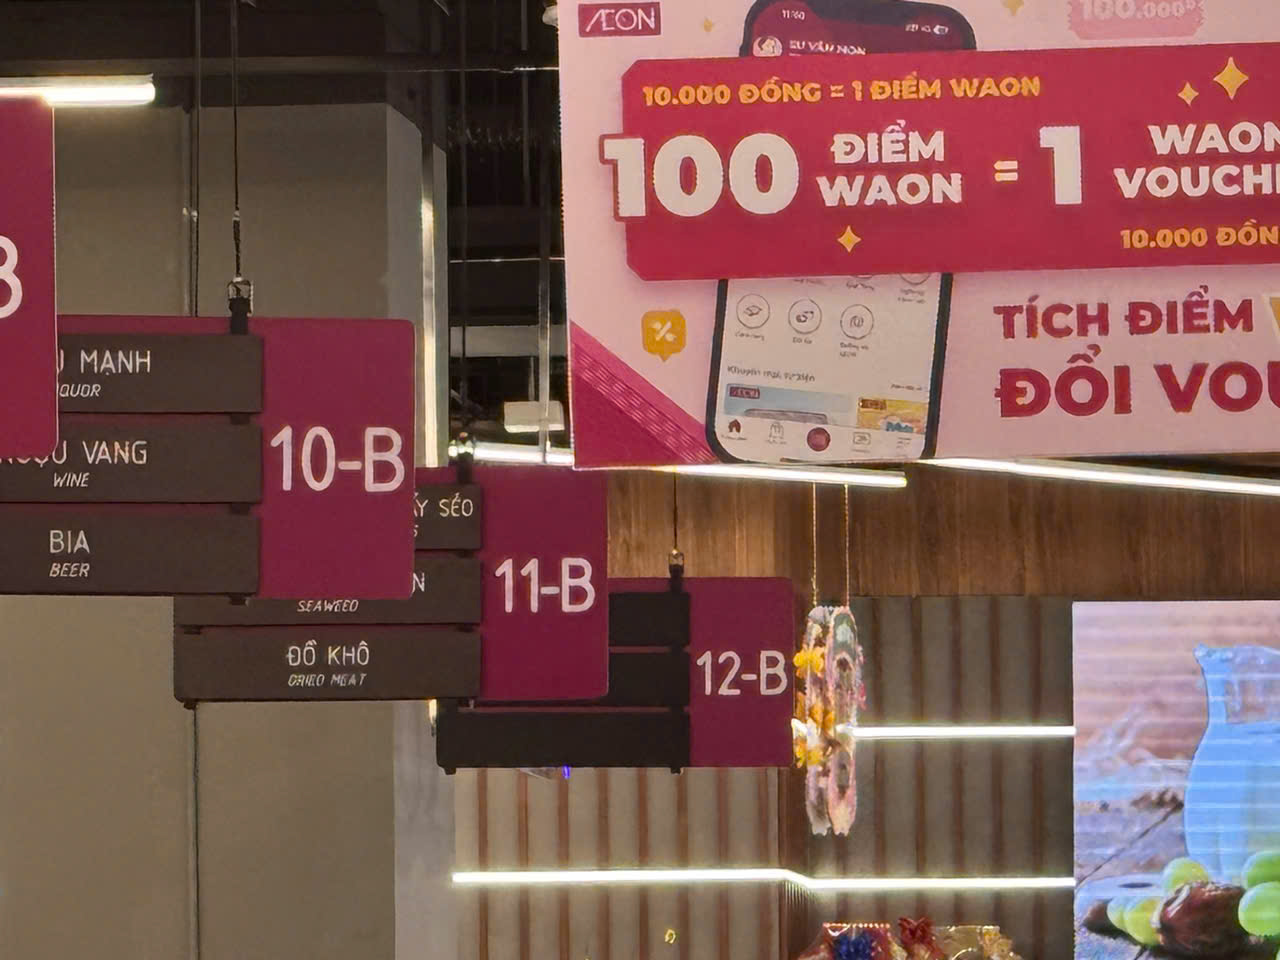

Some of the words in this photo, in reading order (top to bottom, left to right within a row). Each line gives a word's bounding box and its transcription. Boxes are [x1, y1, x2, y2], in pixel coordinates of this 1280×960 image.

[641, 84, 731, 106] 10.000
[852, 82, 862, 102] 1
[950, 76, 1041, 99] WAON
[831, 119, 945, 164] ĐIỂM
[603, 132, 800, 217] 100
[994, 160, 1019, 181] =
[1039, 125, 1082, 205] 1
[816, 172, 963, 206] WAON
[1120, 227, 1208, 249] 10.000
[993, 294, 1109, 340] TÍCH
[1124, 285, 1254, 335] ĐIỂM
[80, 350, 151, 376] MẠNH
[59, 384, 102, 398] QUOR
[994, 343, 1131, 417] ĐỔI
[82, 440, 148, 465] VANG
[270, 426, 405, 492] 10-B
[53, 472, 90, 487] WINE
[49, 530, 91, 554] BIA
[49, 563, 91, 578] BEER
[495, 557, 596, 613] 11-B
[297, 599, 359, 612] SEAWEED
[286, 639, 318, 666] ĐỒ
[327, 640, 370, 666] KHÔ
[330, 673, 367, 687] MEAT
[696, 649, 788, 697] 12-B
